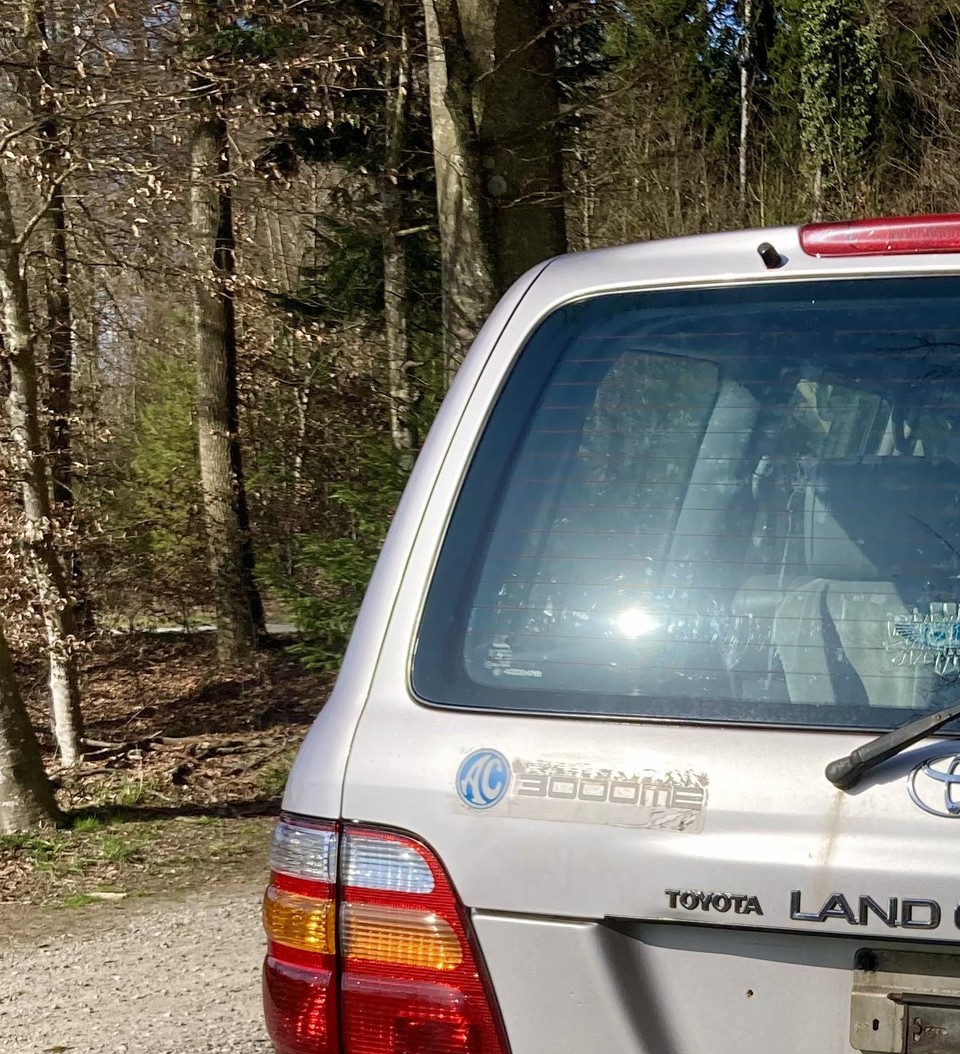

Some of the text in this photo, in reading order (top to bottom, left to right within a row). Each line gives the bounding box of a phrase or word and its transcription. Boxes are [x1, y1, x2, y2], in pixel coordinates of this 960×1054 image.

[460, 753, 504, 806] AC
[664, 888, 764, 916] TOYOTA
[789, 889, 942, 930] LAND
